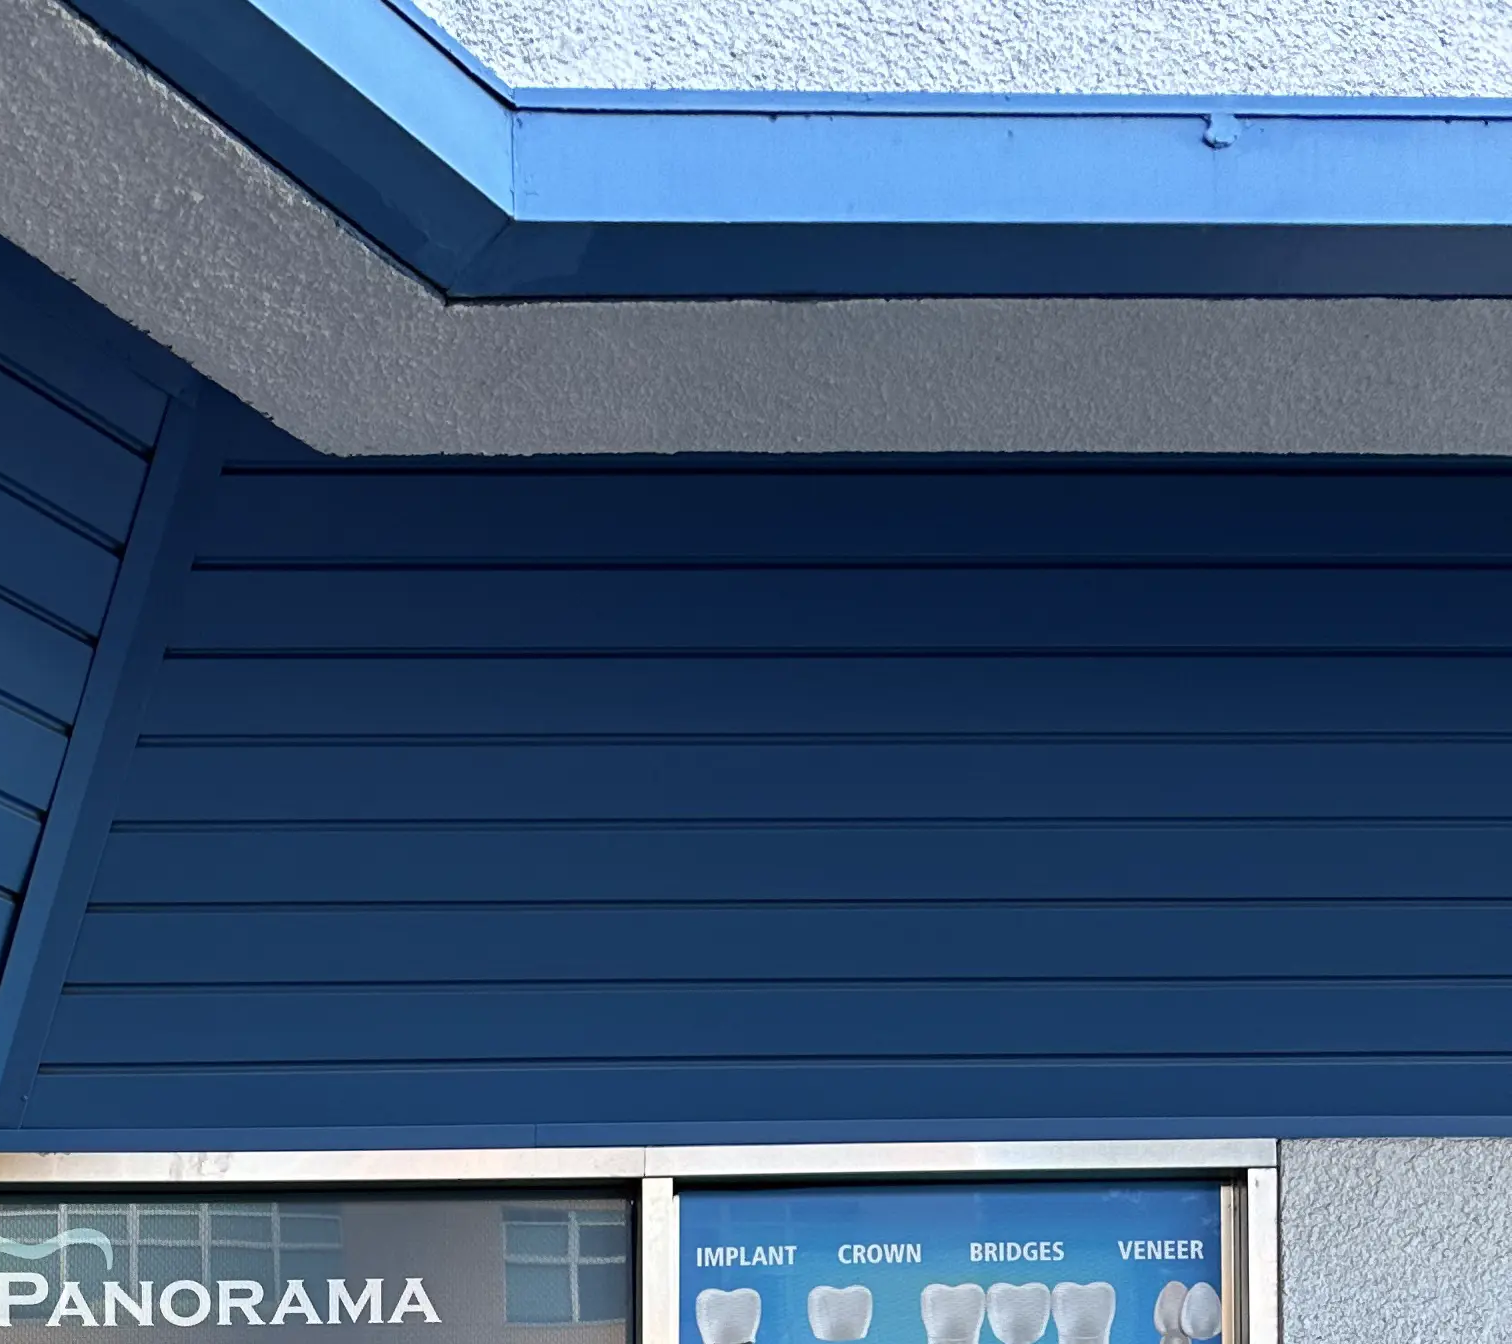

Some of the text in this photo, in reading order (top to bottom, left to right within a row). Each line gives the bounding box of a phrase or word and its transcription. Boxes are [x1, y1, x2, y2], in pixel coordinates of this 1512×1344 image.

[697, 1246, 796, 1266] IMPLANT
[838, 1244, 921, 1264] CROWN
[970, 1242, 1064, 1262] BRIDGES
[1118, 1240, 1203, 1260] VENEER
